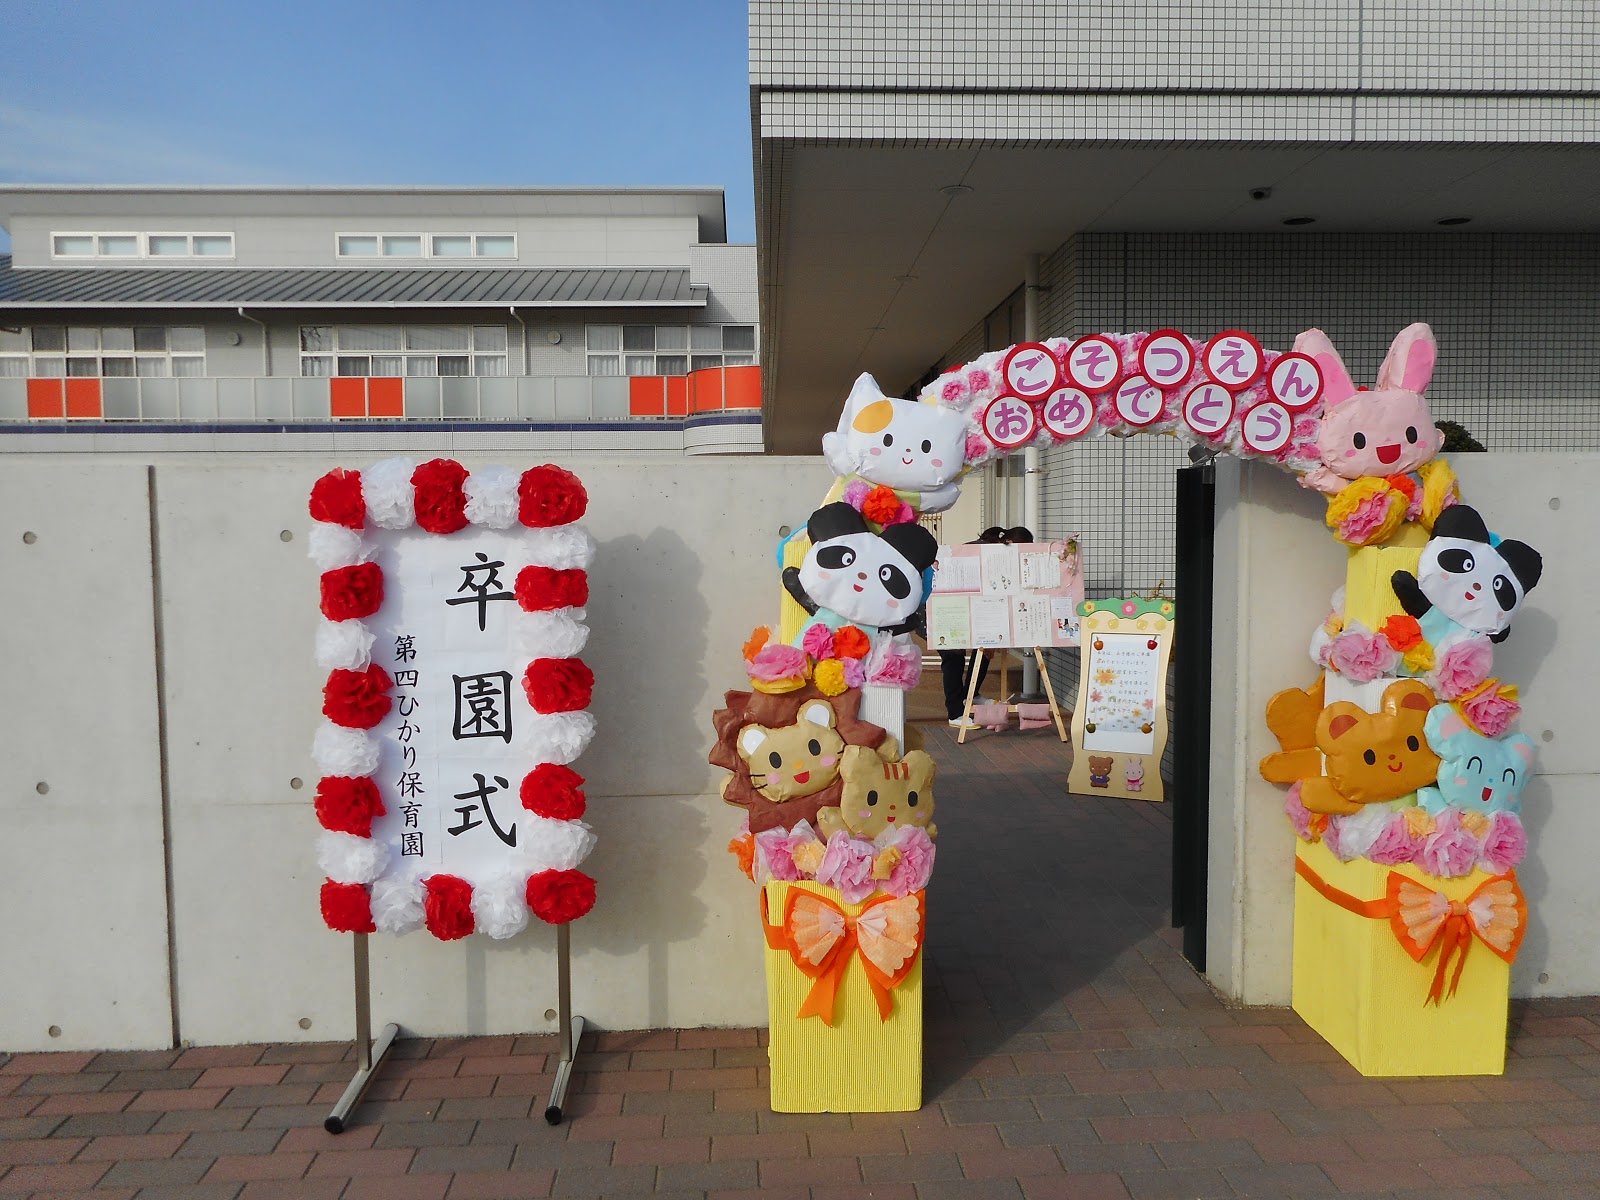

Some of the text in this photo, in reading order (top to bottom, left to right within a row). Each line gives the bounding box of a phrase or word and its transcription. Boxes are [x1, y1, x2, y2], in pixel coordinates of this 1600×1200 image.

[994, 384, 1283, 443] おめでとう
[1014, 340, 1314, 398] ごそつえん
[394, 634, 425, 858] 第四ひかり保育園
[446, 552, 517, 848] 卒園式
